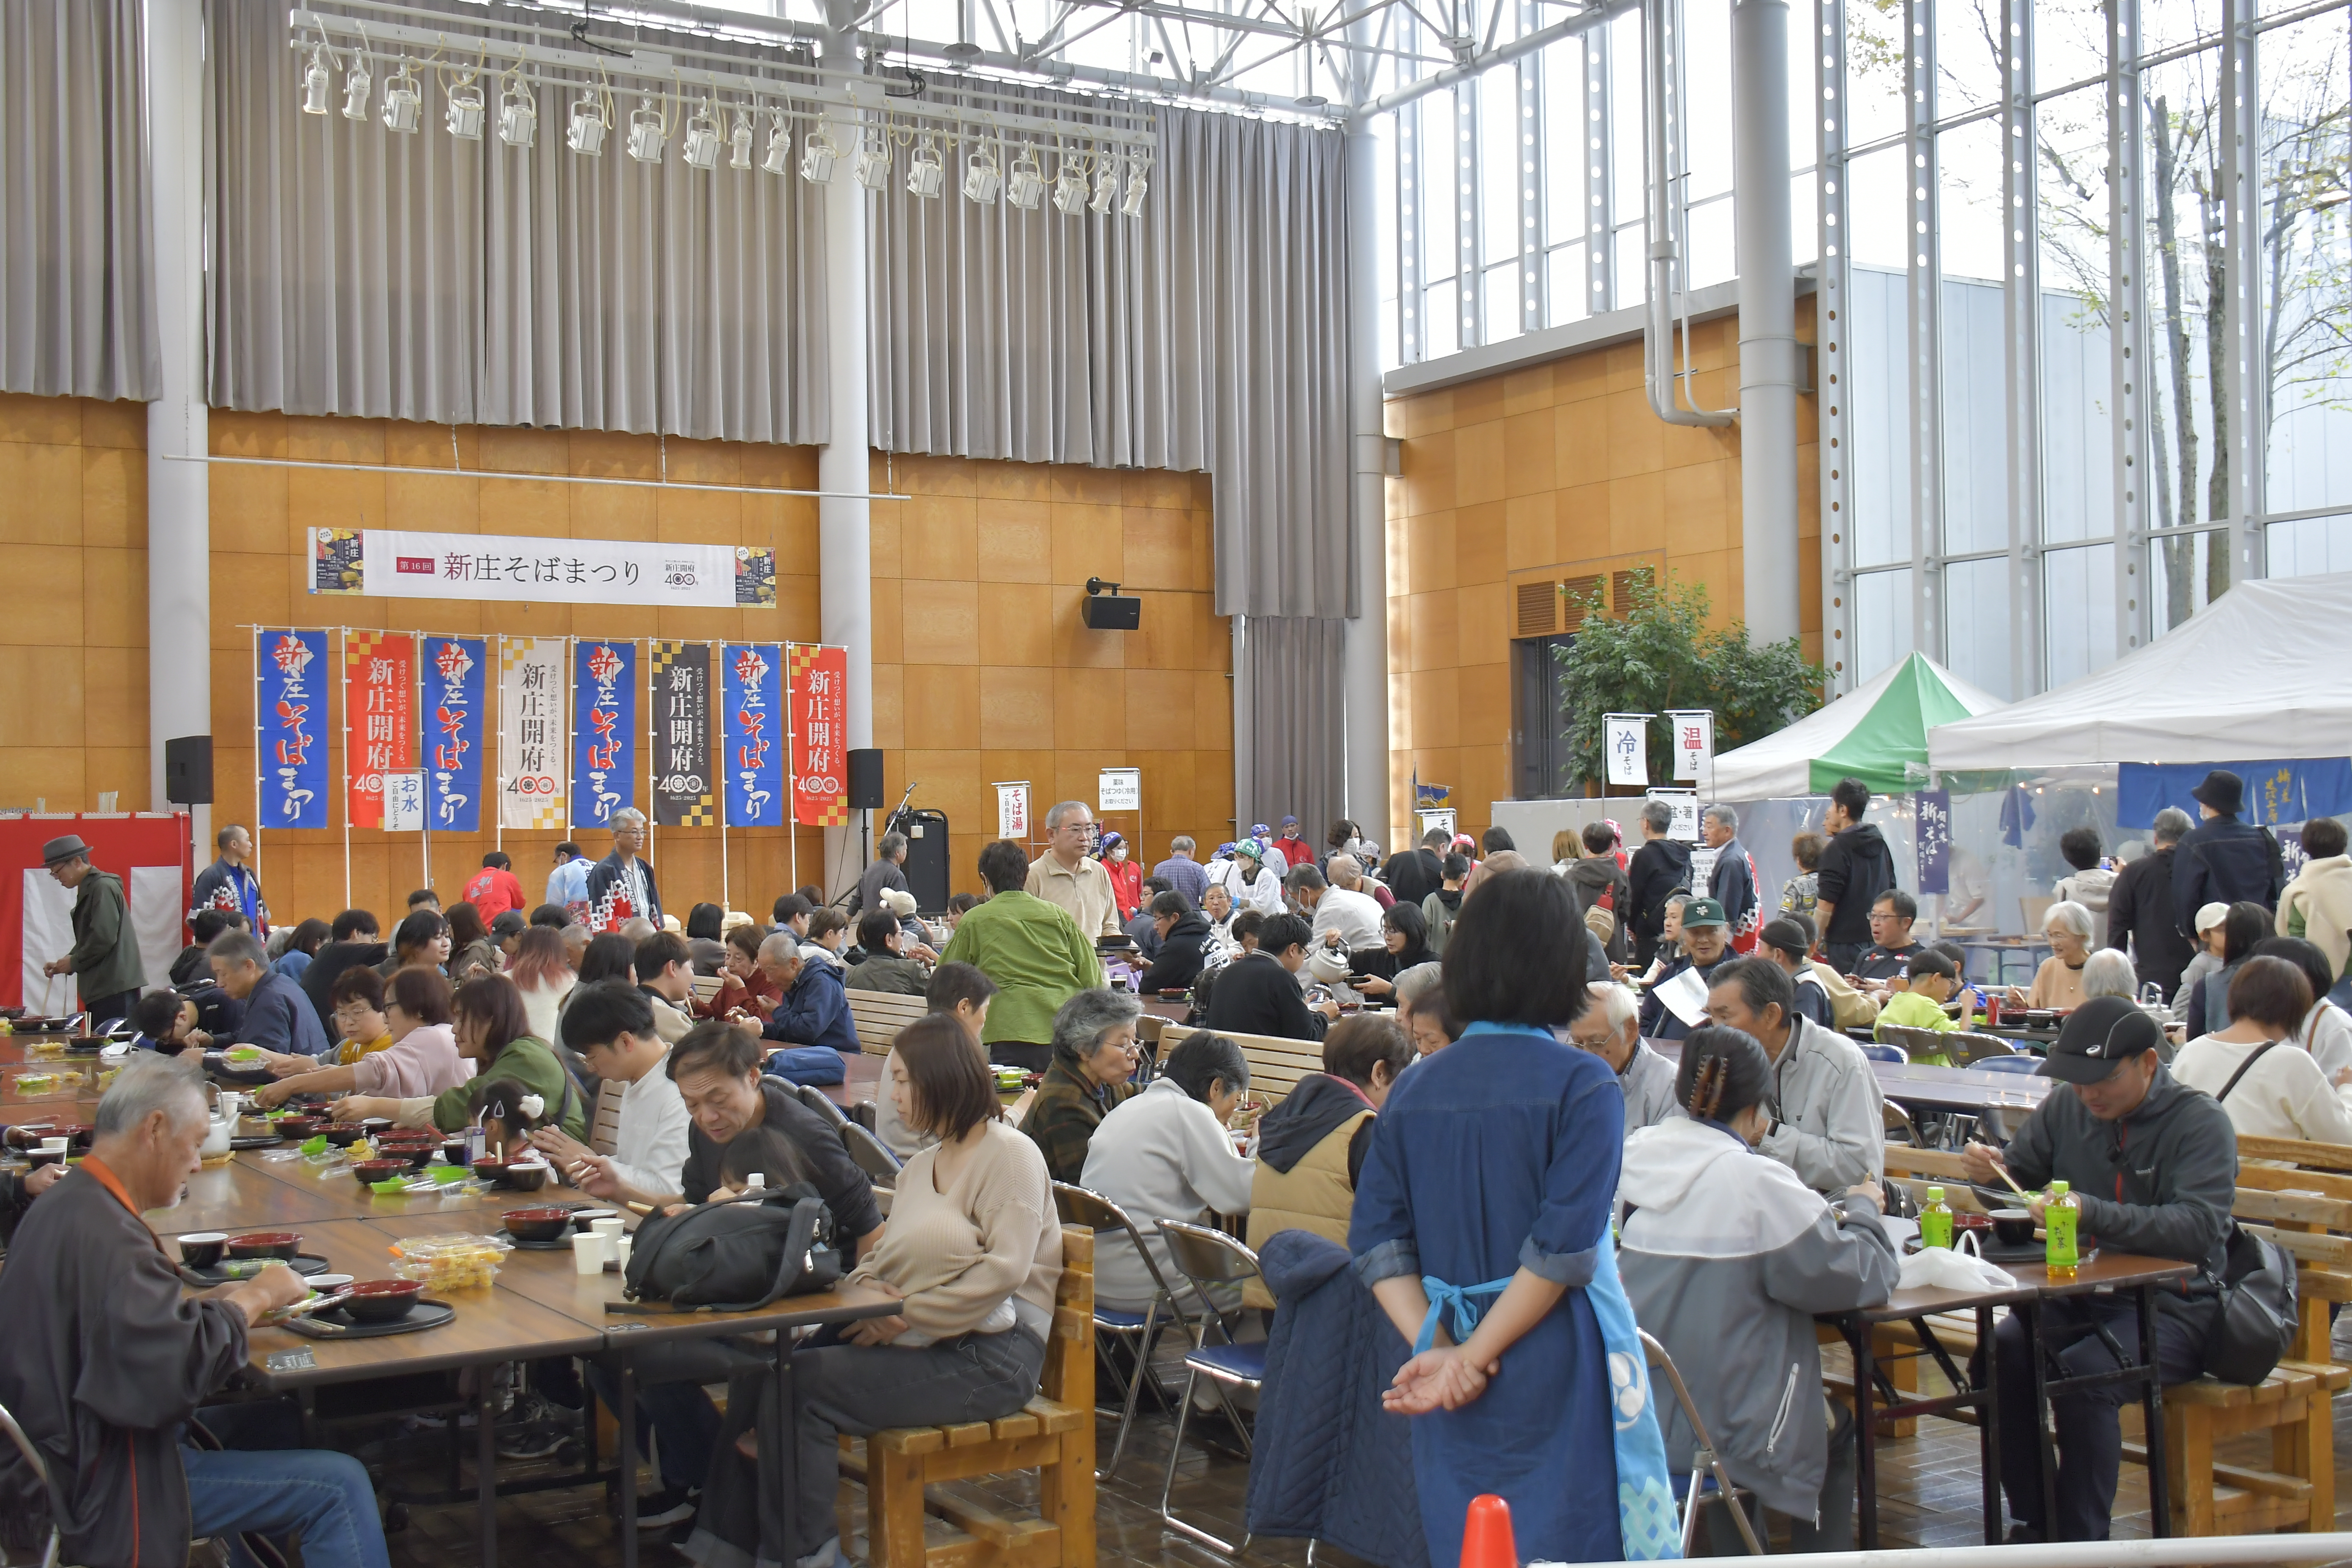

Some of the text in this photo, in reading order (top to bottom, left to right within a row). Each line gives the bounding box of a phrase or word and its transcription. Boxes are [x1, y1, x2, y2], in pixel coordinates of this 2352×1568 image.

[350, 539, 359, 557] 新庄
[400, 560, 432, 572] 第16回
[444, 552, 639, 586] 新庄そばまつり
[665, 564, 695, 572] 新庄開府
[764, 556, 771, 573] 新庄
[273, 635, 314, 822] 新庄そばまつり
[367, 657, 395, 770] 新庄開府
[398, 660, 406, 765] 受けつぐ想いが、未来をつくる。
[435, 642, 474, 826] 新庄そばまつり
[520, 663, 546, 772] 新庄開府
[550, 665, 558, 767] 受けつぐ想いが、未来をつくる。
[588, 645, 625, 824] 新庄そばまつり
[669, 666, 694, 772] 新庄開府
[734, 649, 770, 822] 新庄そばまつり
[807, 669, 830, 773] 新庄開府
[401, 776, 419, 812] お水
[1012, 789, 1023, 830] そば湯
